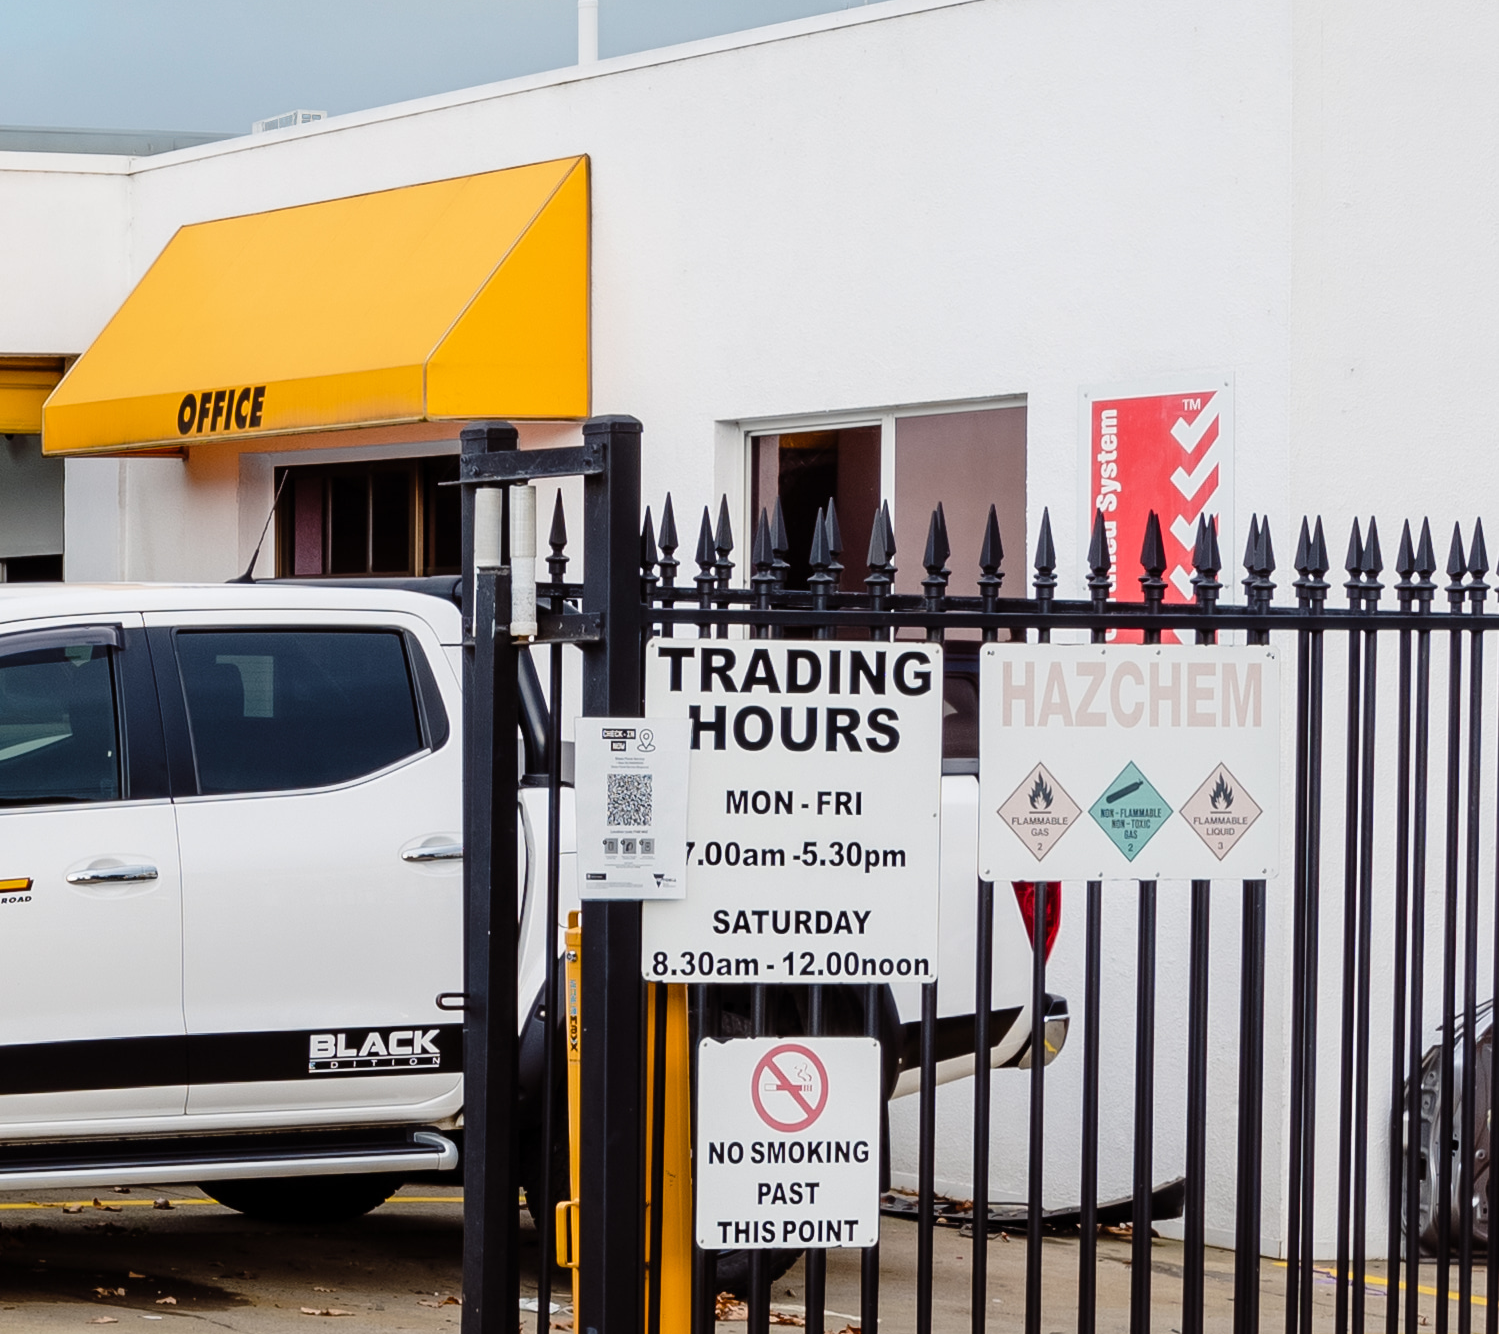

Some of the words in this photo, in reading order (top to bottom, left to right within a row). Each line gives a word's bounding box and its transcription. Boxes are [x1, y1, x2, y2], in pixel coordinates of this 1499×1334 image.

[178, 385, 267, 435] OFFICE
[1096, 409, 1121, 512] System
[657, 646, 933, 697] TRADING
[1001, 661, 1263, 728] HAZCHEM
[690, 704, 902, 754] HOURS
[725, 790, 794, 817] MON
[816, 790, 863, 817] FRI
[1011, 817, 1068, 826] FLAMMABLE
[1030, 827, 1049, 837] GAS
[1193, 816, 1248, 826] FLAMMABLE
[1206, 827, 1235, 837] LIQUID
[1037, 842, 1043, 851] 2
[1124, 829, 1138, 840] GAS
[1217, 842, 1224, 851] 3
[685, 840, 786, 867] 7.00am
[1128, 843, 1134, 852] 2
[1, 895, 33, 904] ROAD
[712, 909, 872, 936] SATURDAY
[652, 951, 759, 977] 8.30am
[782, 951, 931, 977] 12.00noon
[309, 1029, 441, 1058] BLACK
[308, 1056, 441, 1070] EDITION
[707, 1141, 744, 1164] NO
[750, 1140, 870, 1164] SMOKING
[757, 1182, 820, 1205] PAST
[717, 1220, 776, 1244] THIS
[782, 1219, 859, 1243] POINT
